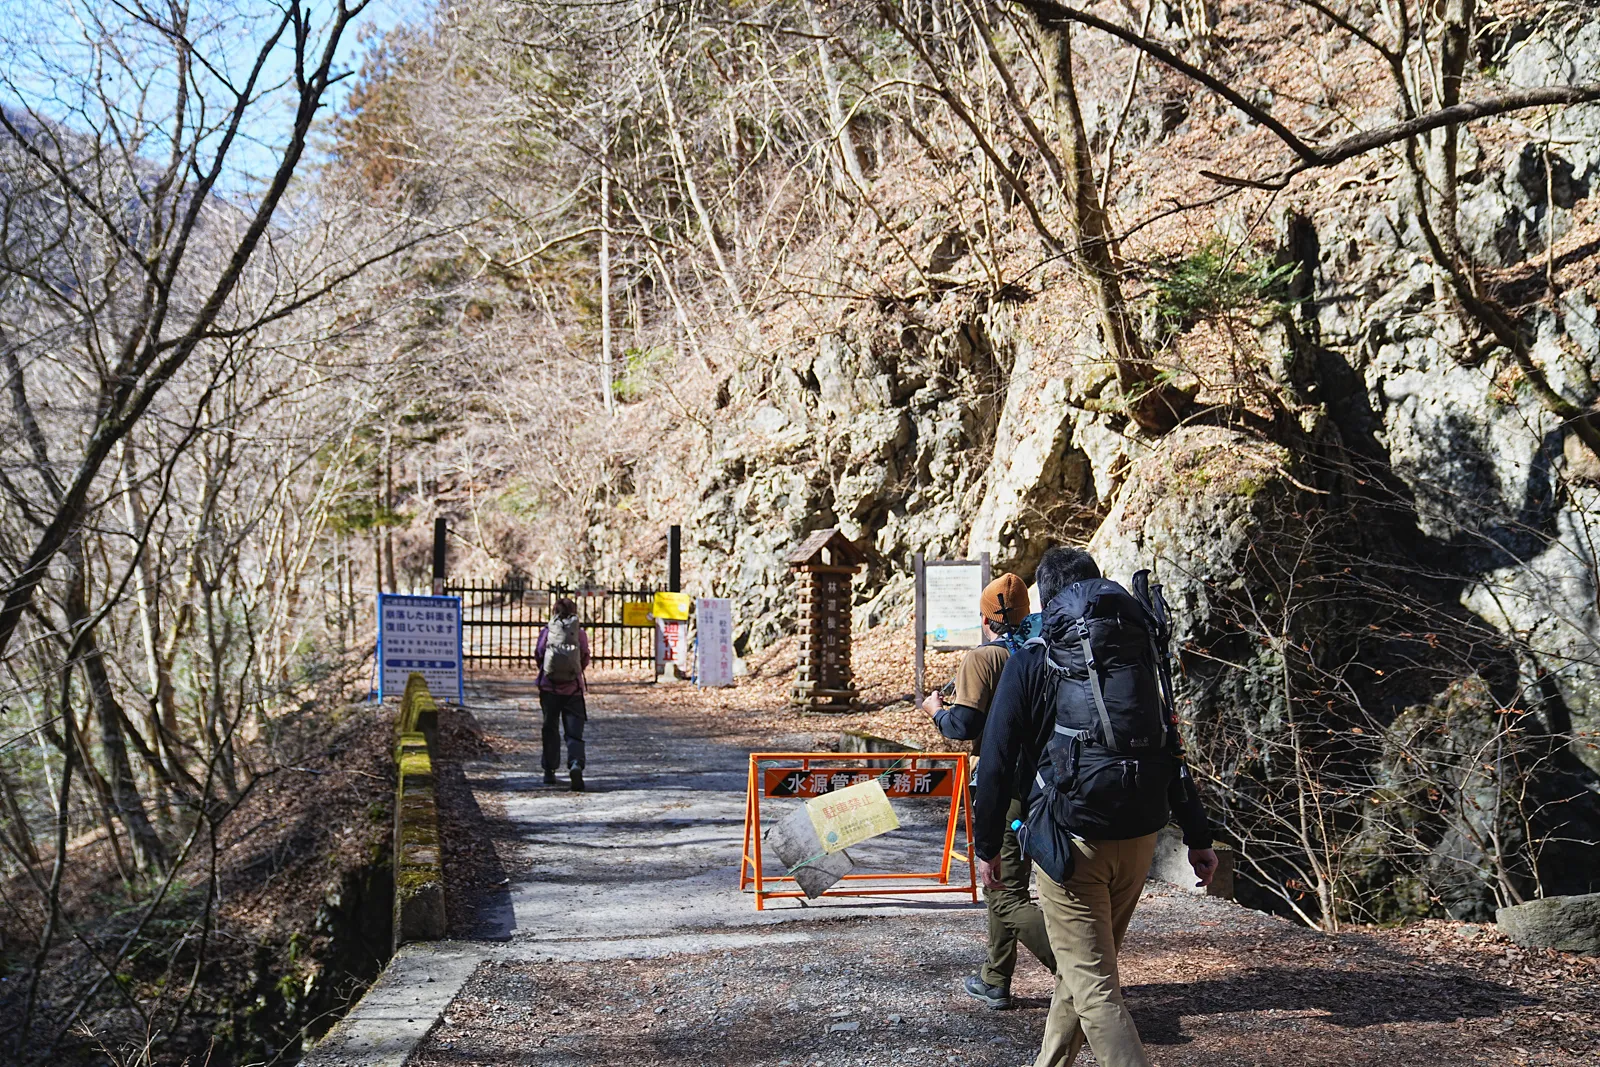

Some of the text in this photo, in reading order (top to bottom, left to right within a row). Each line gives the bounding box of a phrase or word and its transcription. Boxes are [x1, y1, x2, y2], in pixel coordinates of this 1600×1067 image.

[385, 610, 454, 622] 崩落した斜面を
[385, 622, 455, 634] 復旧しています
[821, 794, 875, 820] 駐車禁止
